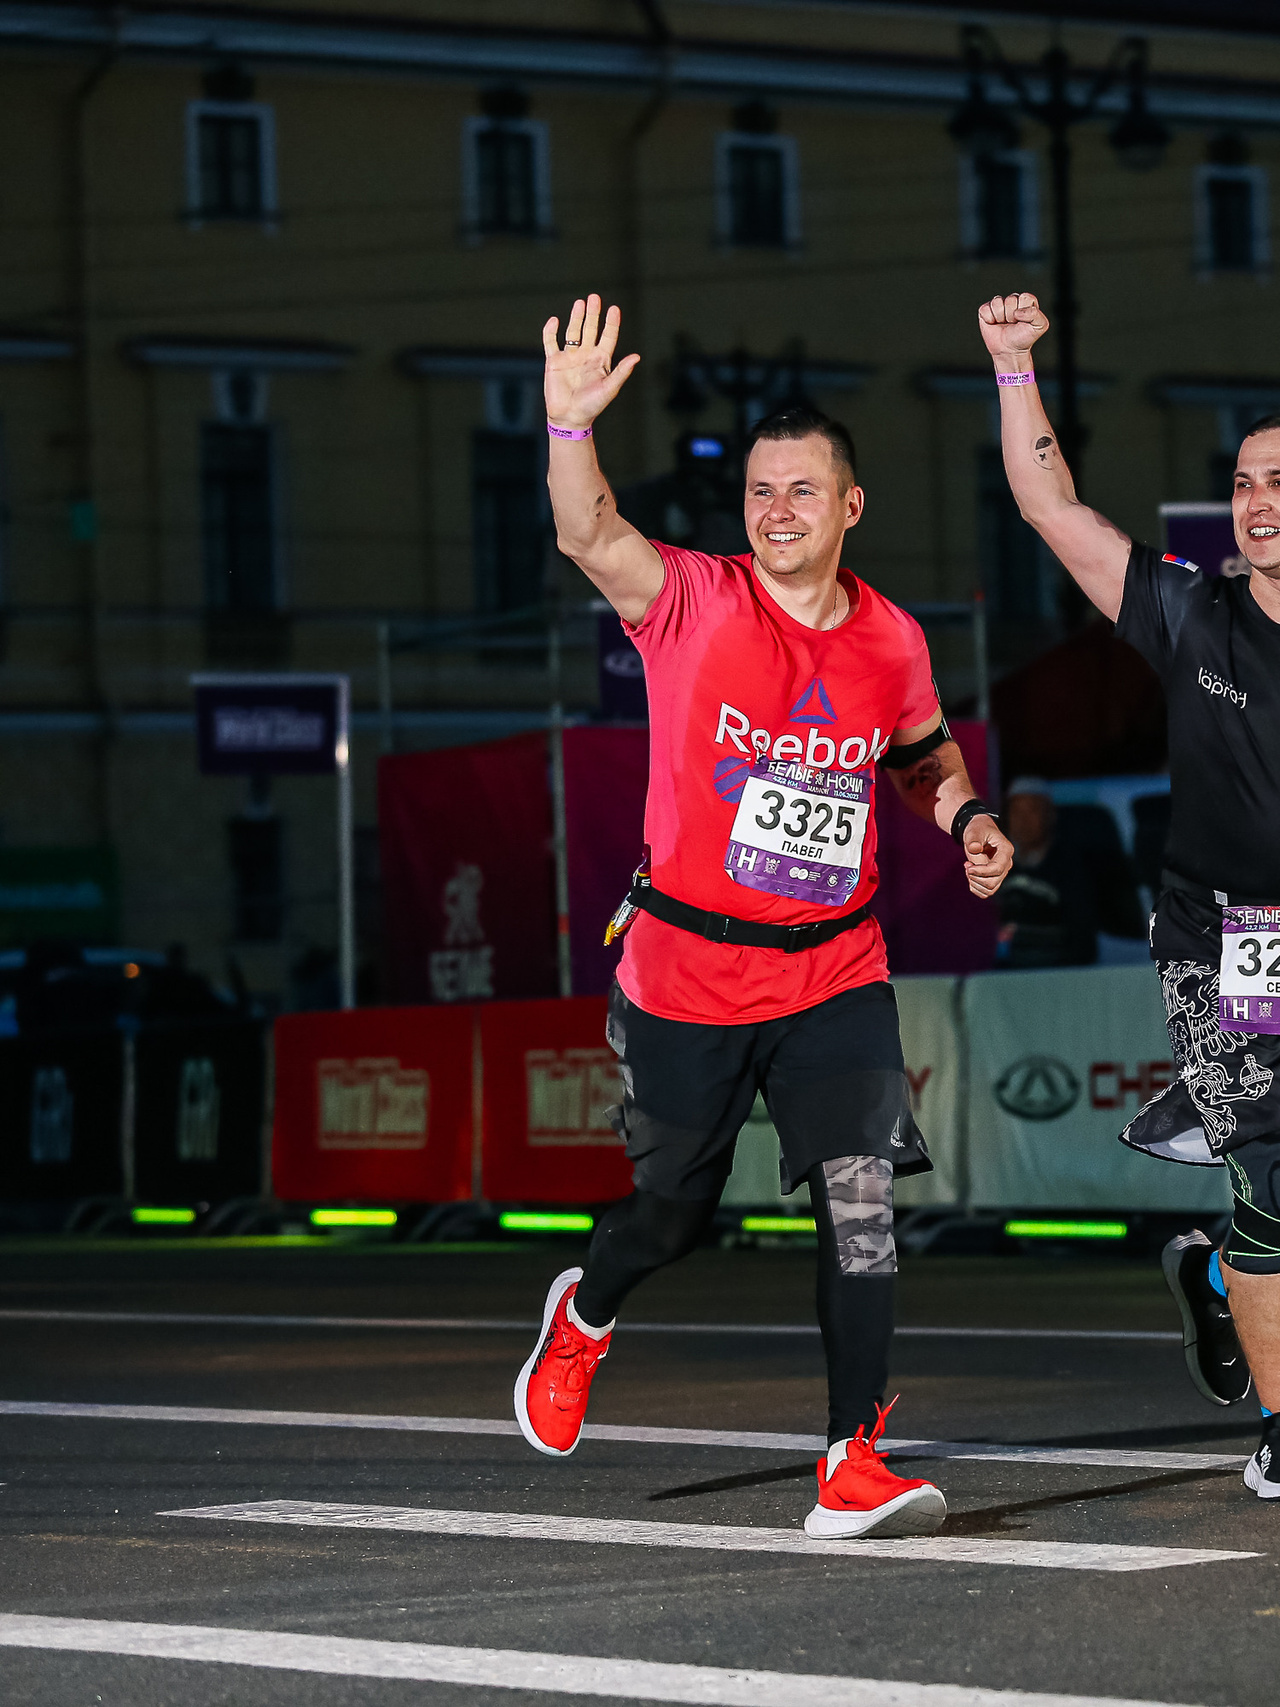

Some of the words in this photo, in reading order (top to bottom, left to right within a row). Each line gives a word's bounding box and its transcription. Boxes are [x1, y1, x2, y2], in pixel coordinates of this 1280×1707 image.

[714, 702, 890, 770] Reebok
[767, 762, 814, 784] БЕЛЫЕ
[827, 772, 864, 793] НОЧИ
[755, 790, 856, 846] 3325
[782, 841, 823, 859] ПАВЕЛ
